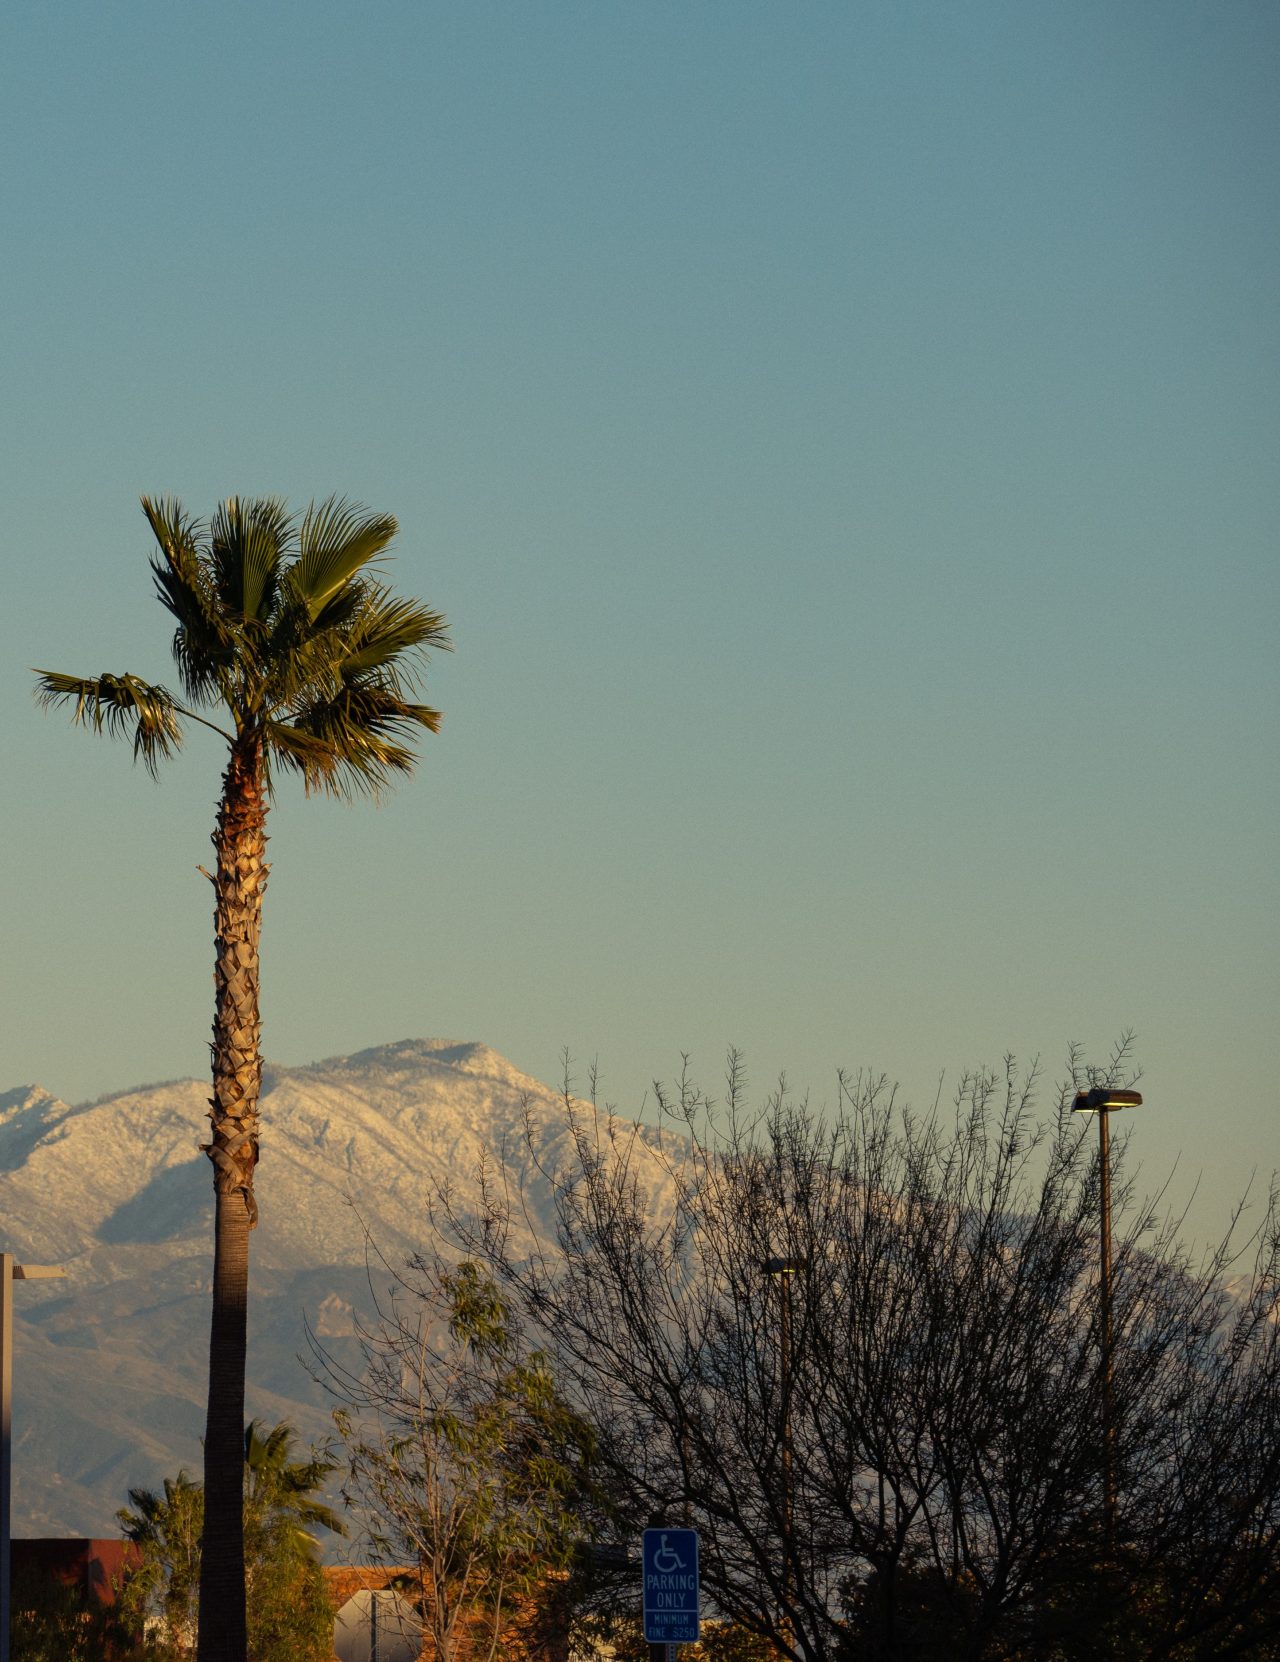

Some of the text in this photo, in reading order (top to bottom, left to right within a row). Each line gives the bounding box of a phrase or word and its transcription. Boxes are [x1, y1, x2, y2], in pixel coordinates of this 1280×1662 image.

[647, 1575, 695, 1590] PARKING
[657, 1593, 686, 1607] ONLY
[654, 1614, 689, 1624] MINIMUM
[649, 1627, 695, 1638] FINE $250
